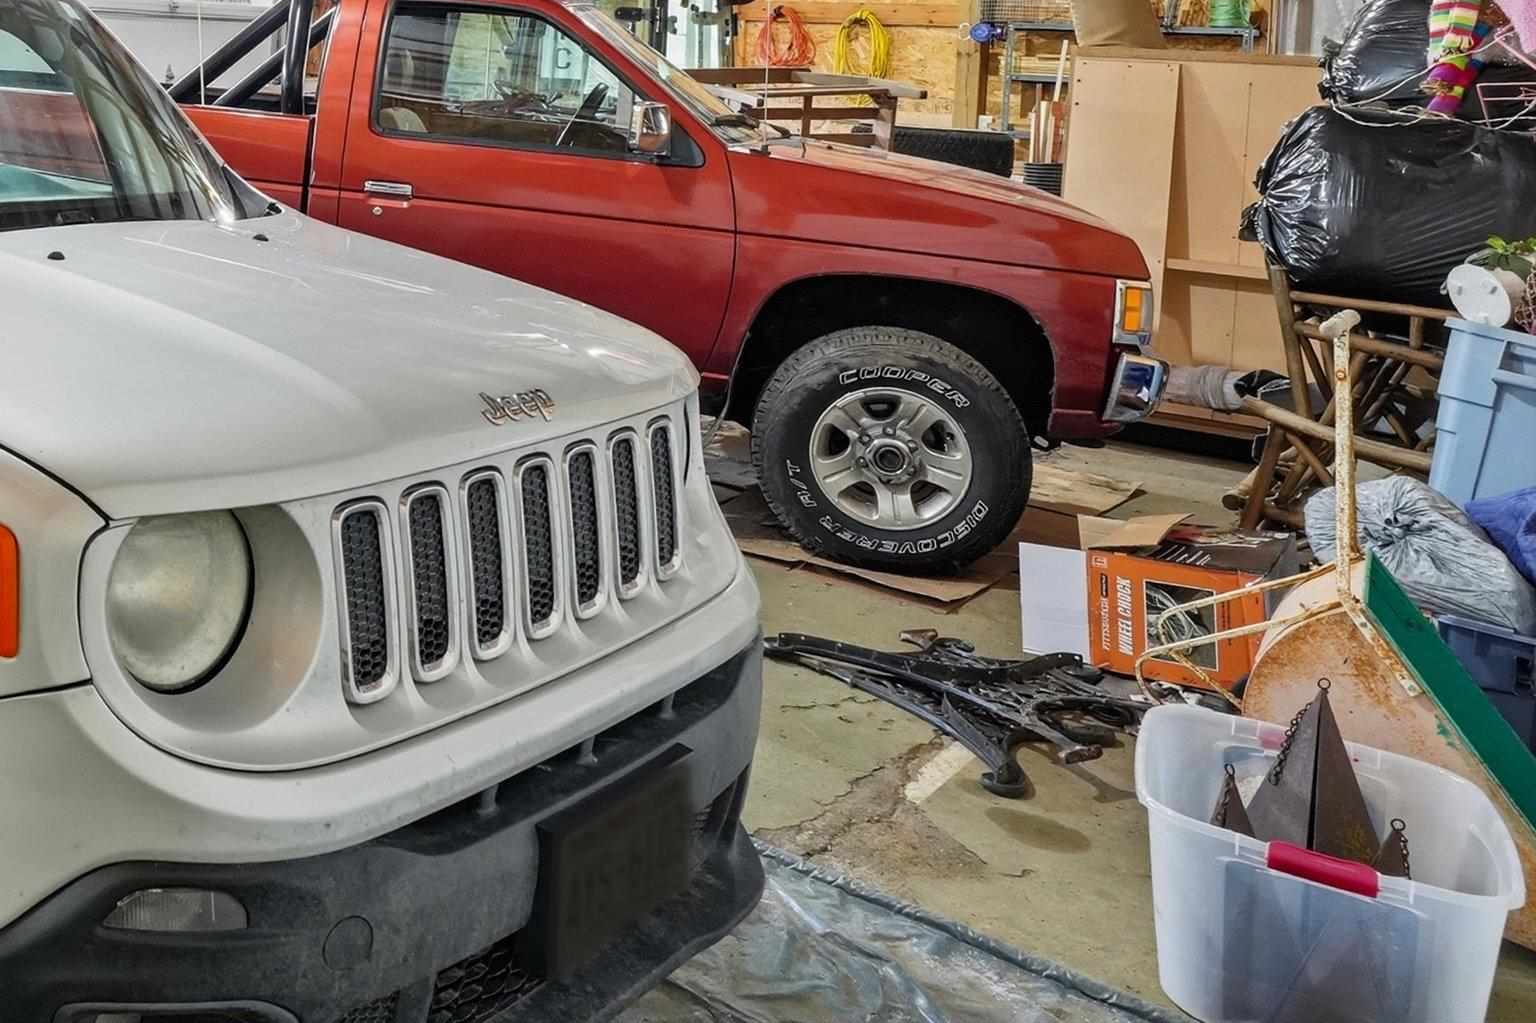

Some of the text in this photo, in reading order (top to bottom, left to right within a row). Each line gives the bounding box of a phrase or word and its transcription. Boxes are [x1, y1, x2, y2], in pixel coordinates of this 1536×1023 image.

[477, 387, 556, 426] Jeep
[838, 366, 970, 408] COOPER
[819, 499, 990, 554] DISCOVERER
[1115, 575, 1134, 656] WHEEL CHOCK
